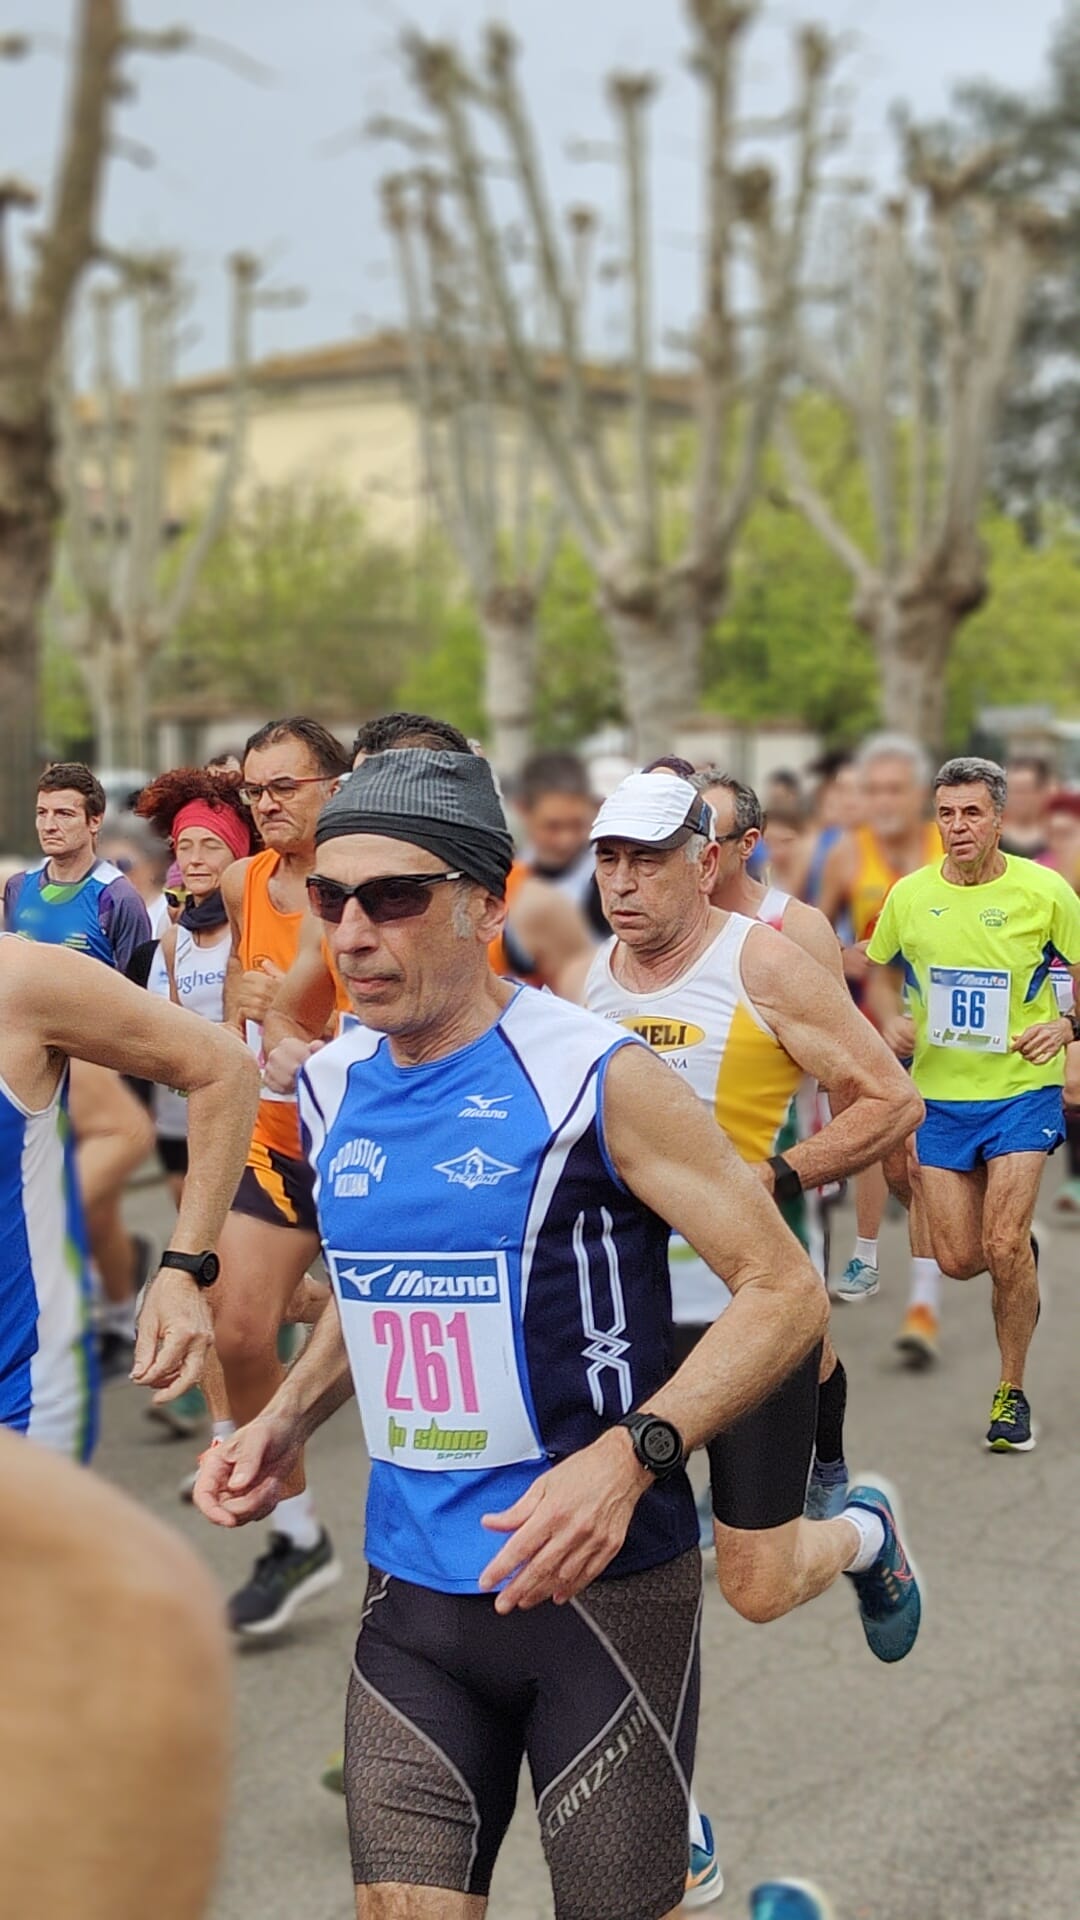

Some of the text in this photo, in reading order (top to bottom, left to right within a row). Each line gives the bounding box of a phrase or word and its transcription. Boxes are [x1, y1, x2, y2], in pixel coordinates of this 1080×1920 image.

[951, 989, 986, 1029] 66
[372, 1310, 480, 1413] 261
[435, 1451, 482, 1460] SPORT
